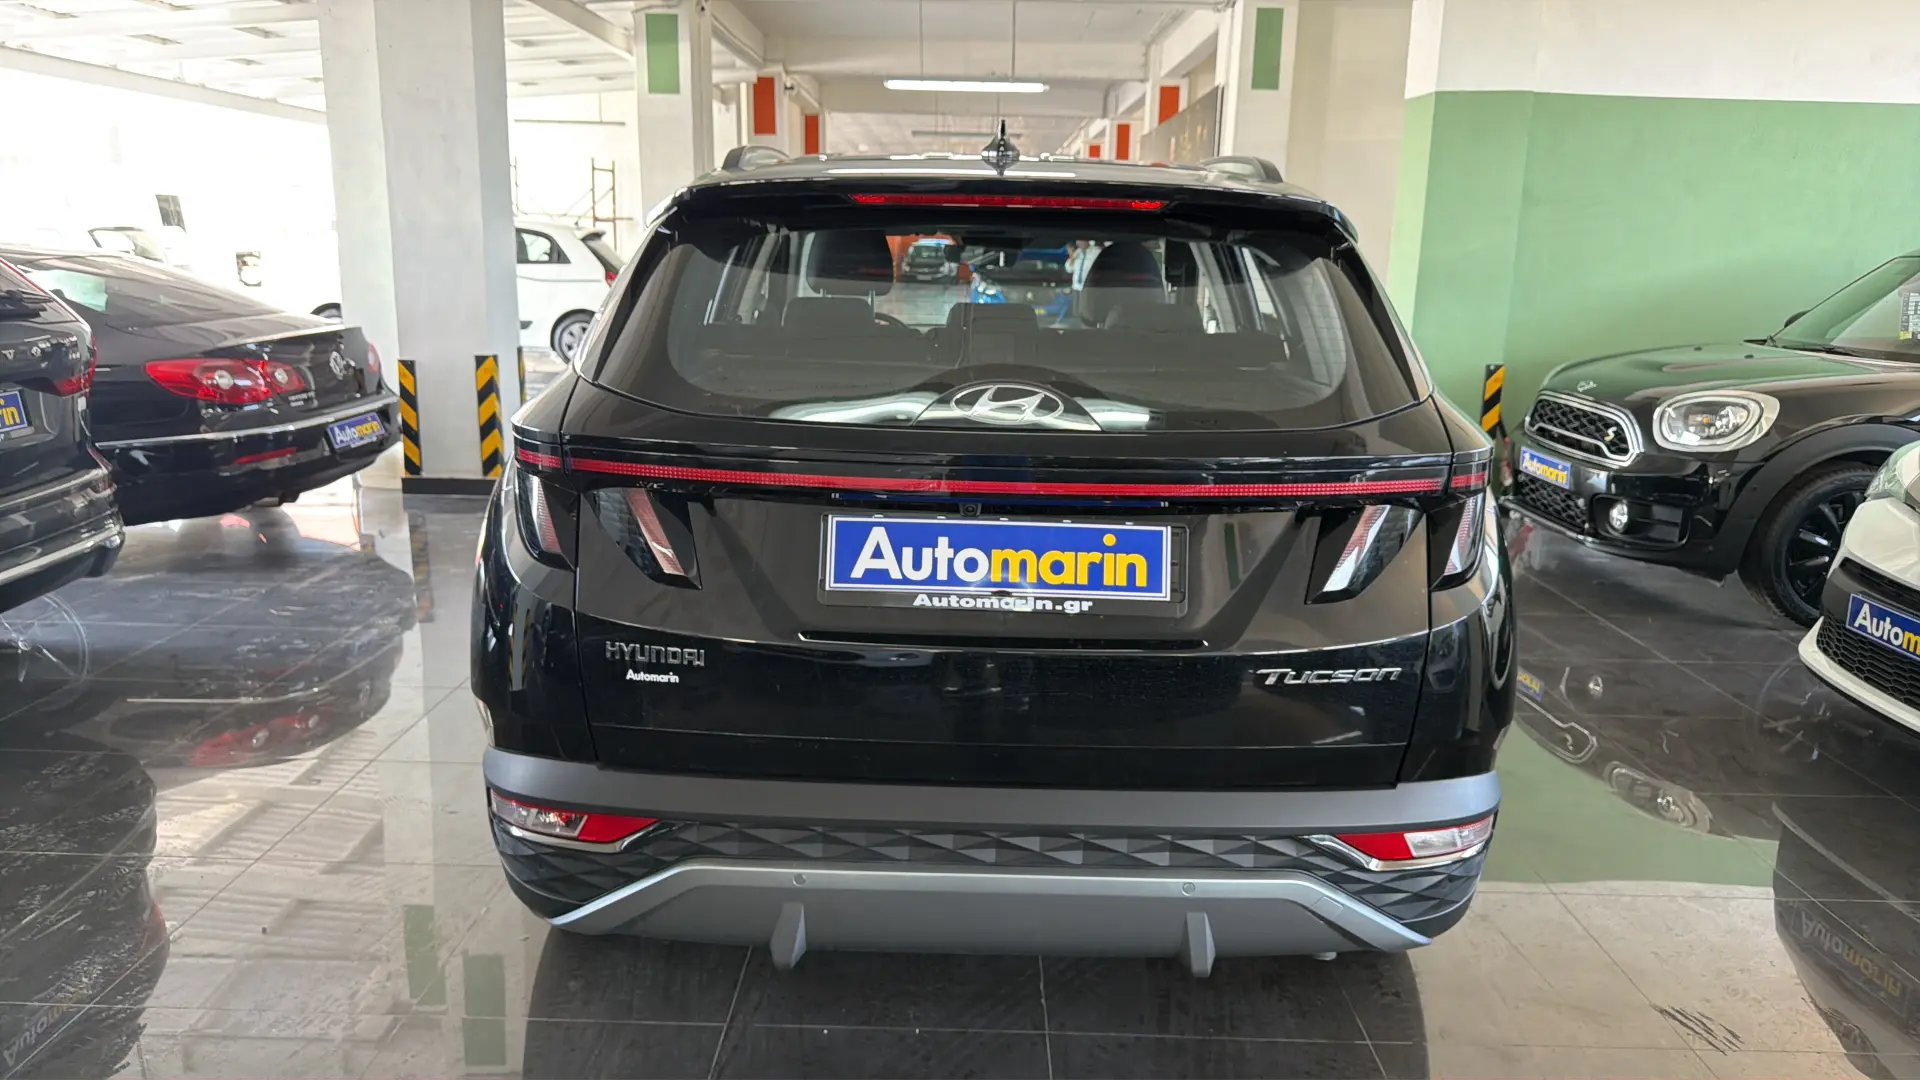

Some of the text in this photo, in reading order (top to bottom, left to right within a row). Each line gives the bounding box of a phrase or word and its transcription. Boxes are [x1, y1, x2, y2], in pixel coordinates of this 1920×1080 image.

[850, 526, 1148, 588] Automarin
[912, 593, 1093, 614] Automarin.gr
[605, 641, 705, 667] HYUNDAI
[626, 668, 680, 684] Automarin
